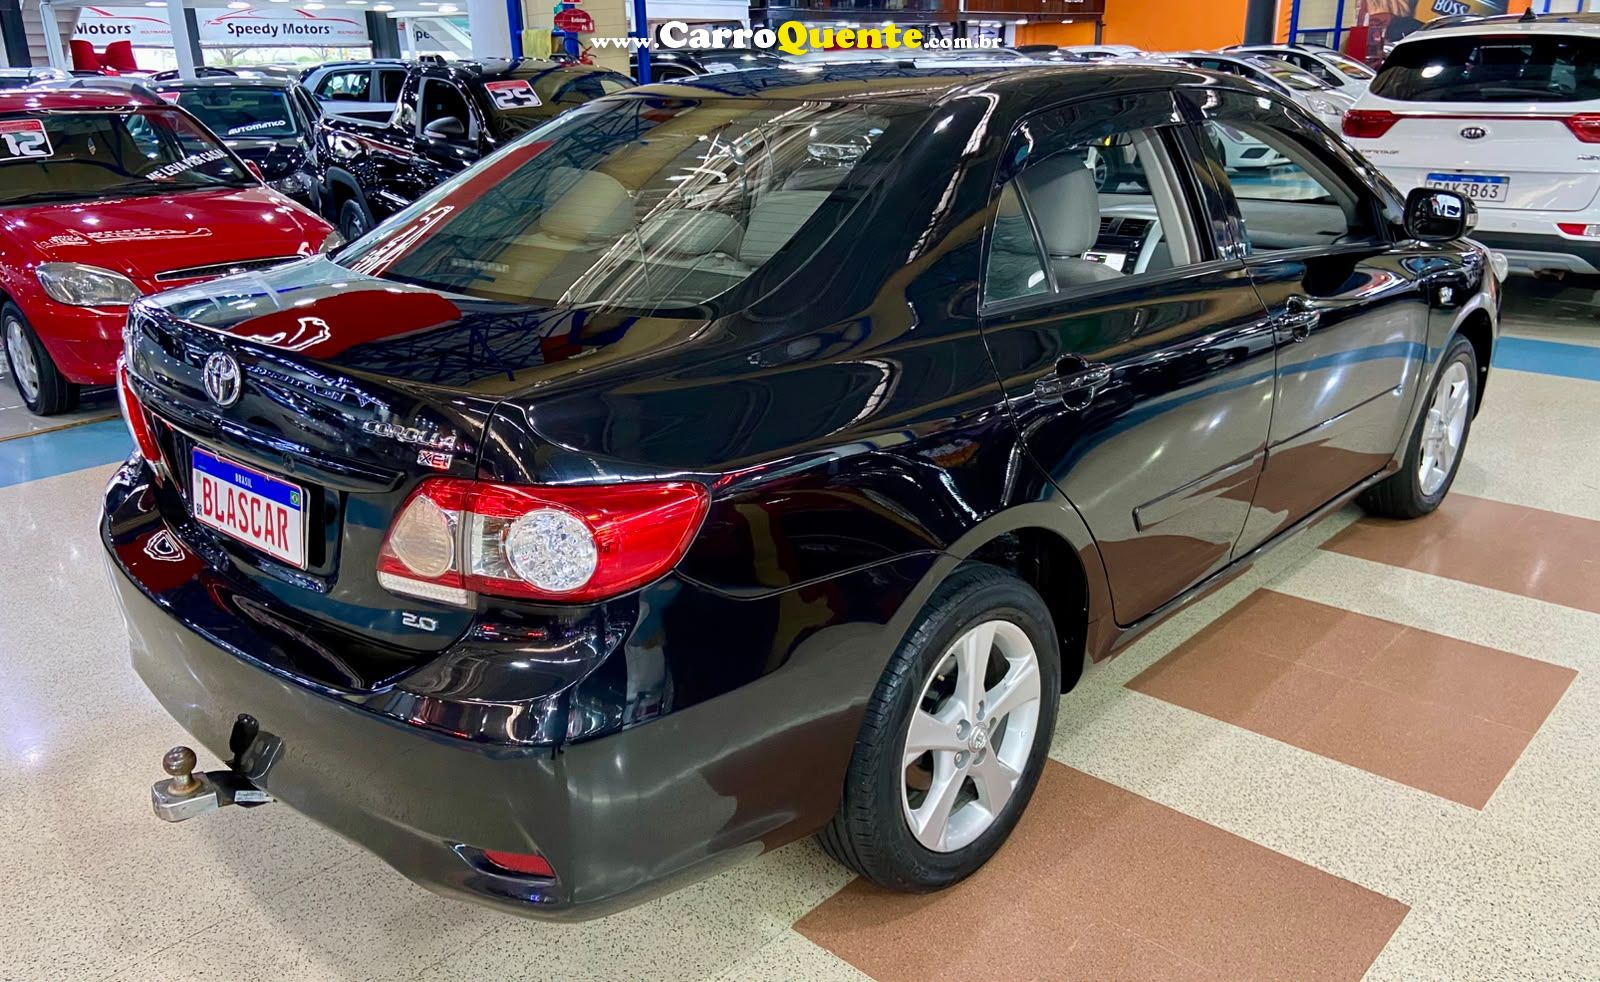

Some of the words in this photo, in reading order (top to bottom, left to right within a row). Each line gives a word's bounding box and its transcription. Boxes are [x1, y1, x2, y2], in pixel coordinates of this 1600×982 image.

[227, 23, 278, 37] Speedy
[283, 23, 330, 34] Motors
[494, 87, 538, 107] 25
[1463, 127, 1484, 138] KIA
[1, 132, 47, 156] 12
[160, 161, 189, 177] LEVA
[362, 420, 457, 451] COROLLA
[234, 472, 253, 488] BRASIL
[202, 477, 289, 552] BLASCAR
